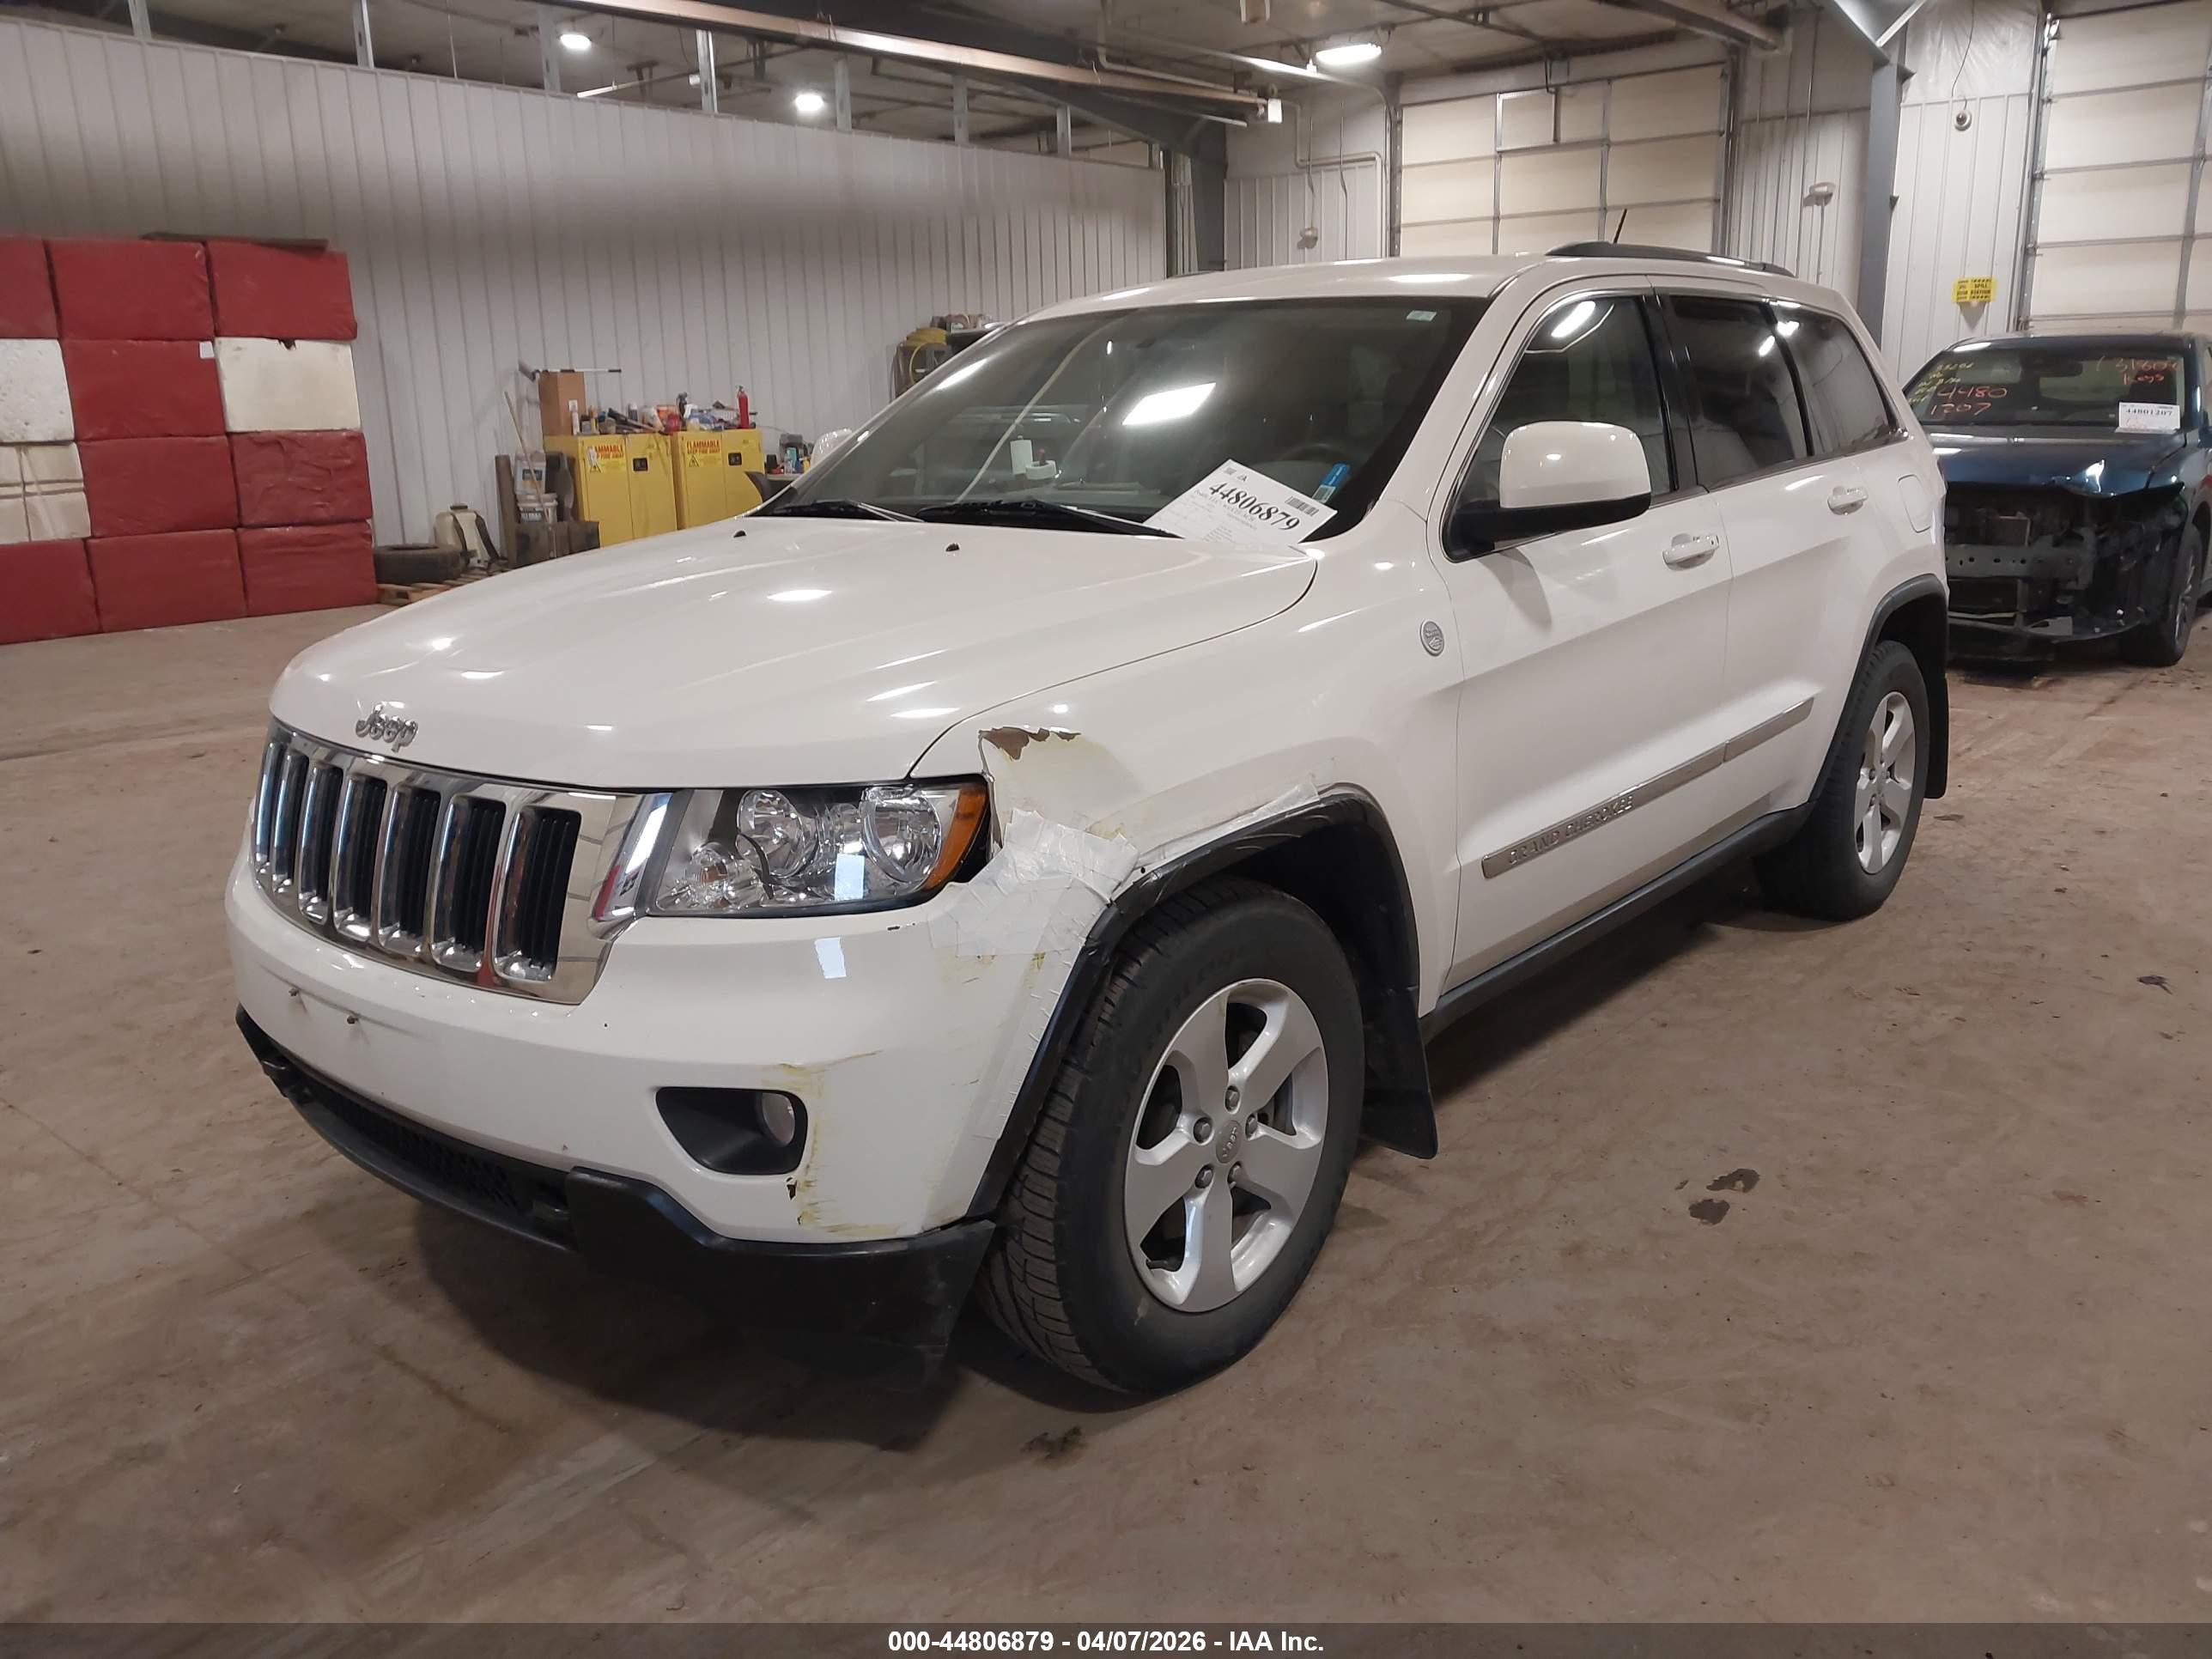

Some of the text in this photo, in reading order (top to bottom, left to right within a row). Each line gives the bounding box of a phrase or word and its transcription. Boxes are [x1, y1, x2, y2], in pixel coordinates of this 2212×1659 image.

[1936, 386, 2008, 398] 4480
[1930, 403, 1992, 416] 1207
[686, 440, 720, 448] FLAMMABLE
[1209, 482, 1300, 531] 44806879
[355, 702, 419, 754] Jeep
[1509, 794, 1632, 865] GRAND CHEROKEE
